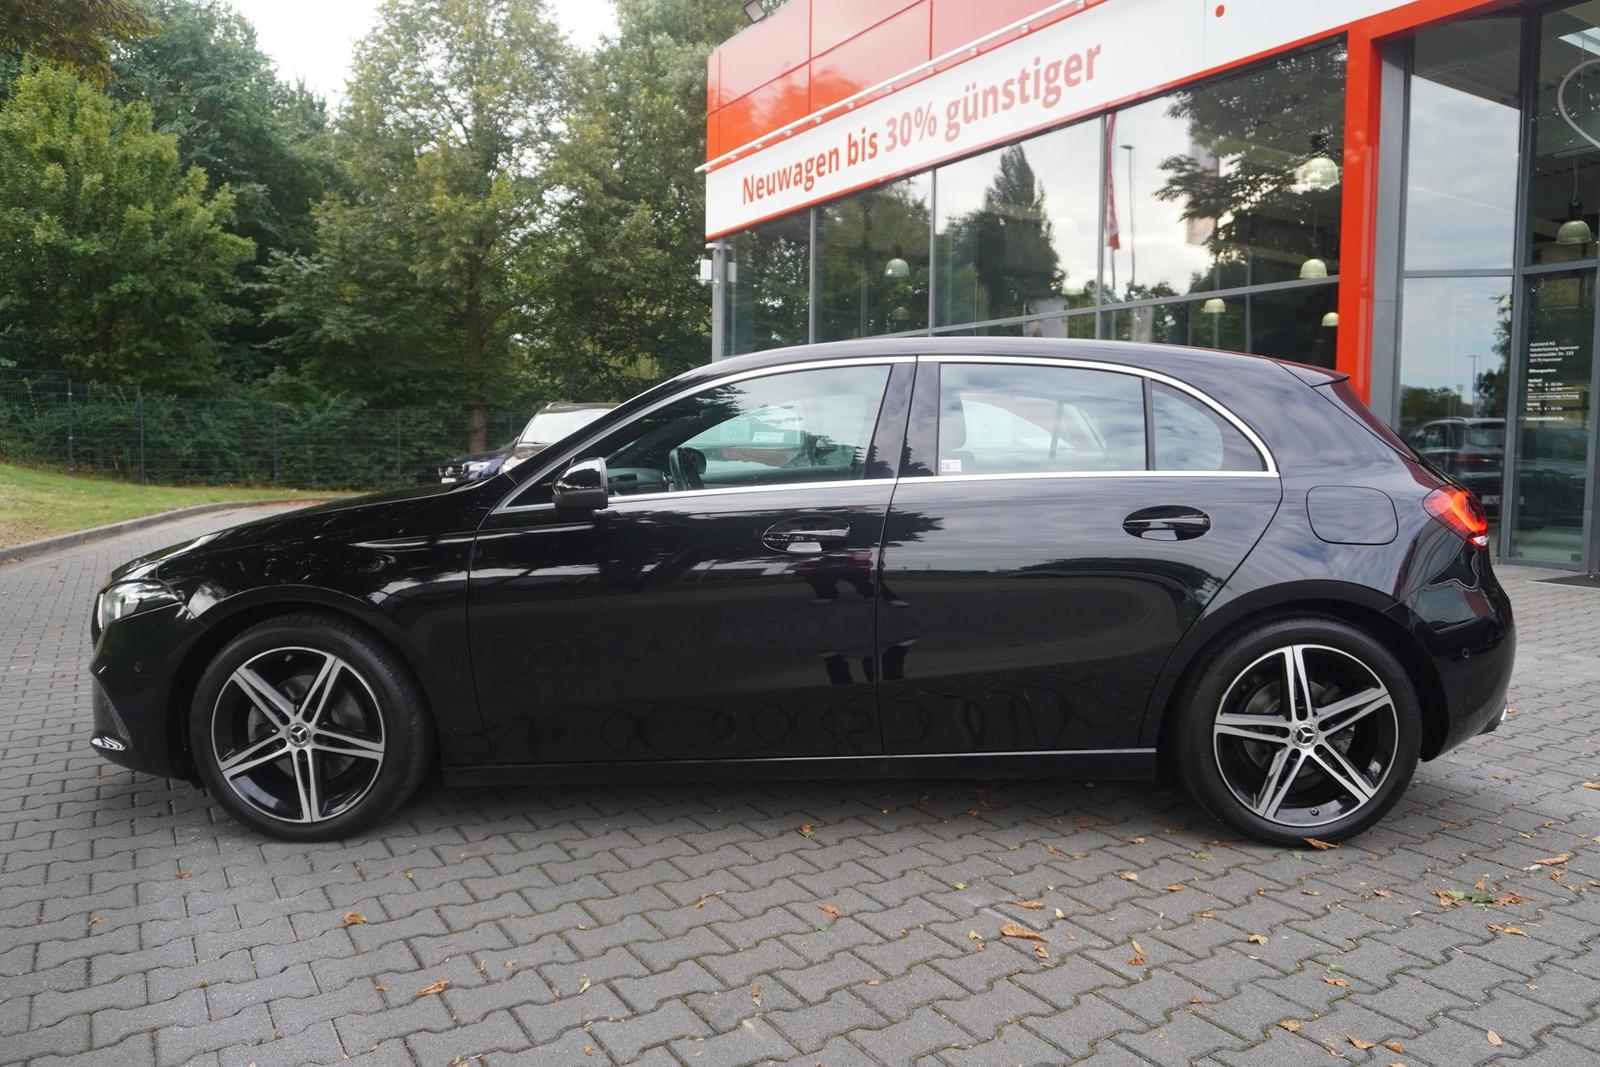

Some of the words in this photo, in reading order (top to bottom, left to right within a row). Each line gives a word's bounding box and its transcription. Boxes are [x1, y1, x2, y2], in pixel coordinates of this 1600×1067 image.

[743, 147, 839, 205] Neuwagen
[847, 127, 878, 167] bis
[885, 102, 937, 152] 30%
[945, 44, 1101, 142] günstiger
